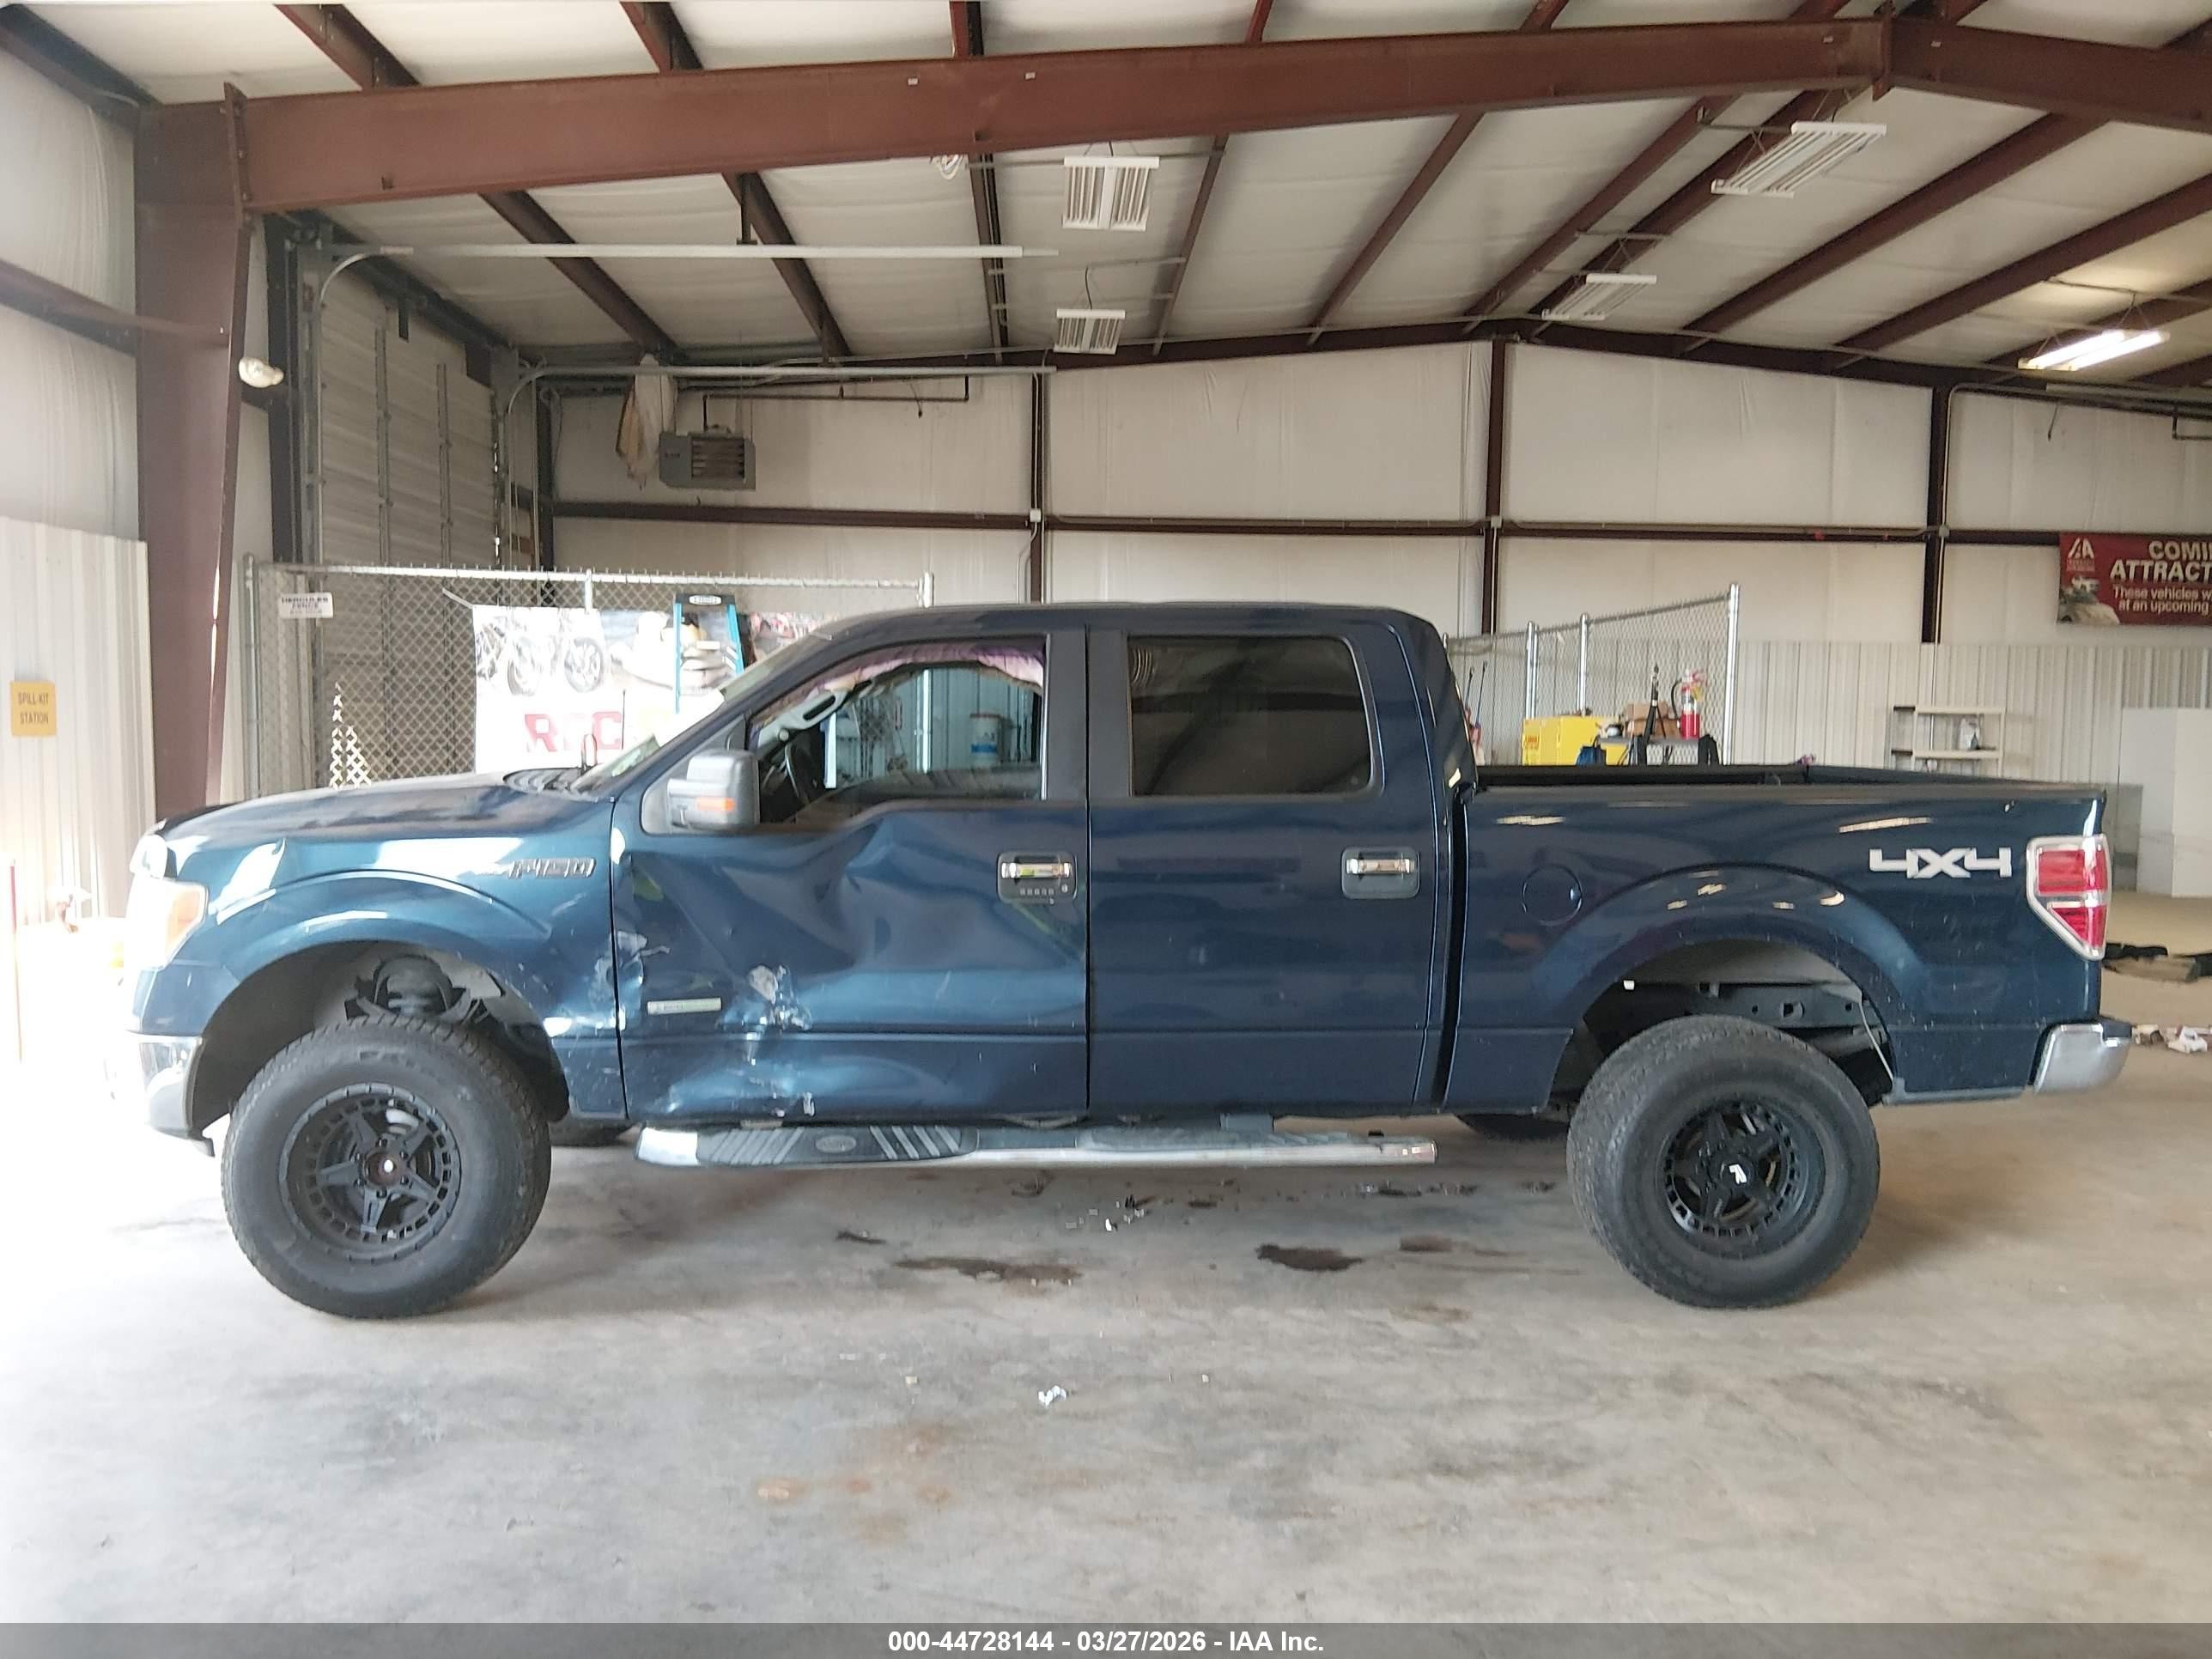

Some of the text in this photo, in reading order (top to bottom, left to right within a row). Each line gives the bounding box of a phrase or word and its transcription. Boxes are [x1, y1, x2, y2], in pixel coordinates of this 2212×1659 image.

[2148, 540, 2212, 561] COMI
[2110, 560, 2212, 583] ATTRACT
[2112, 584, 2147, 599] These
[2151, 586, 2198, 600] vehicles
[2119, 599, 2209, 615] at an upcoming
[20, 711, 49, 725] STATION
